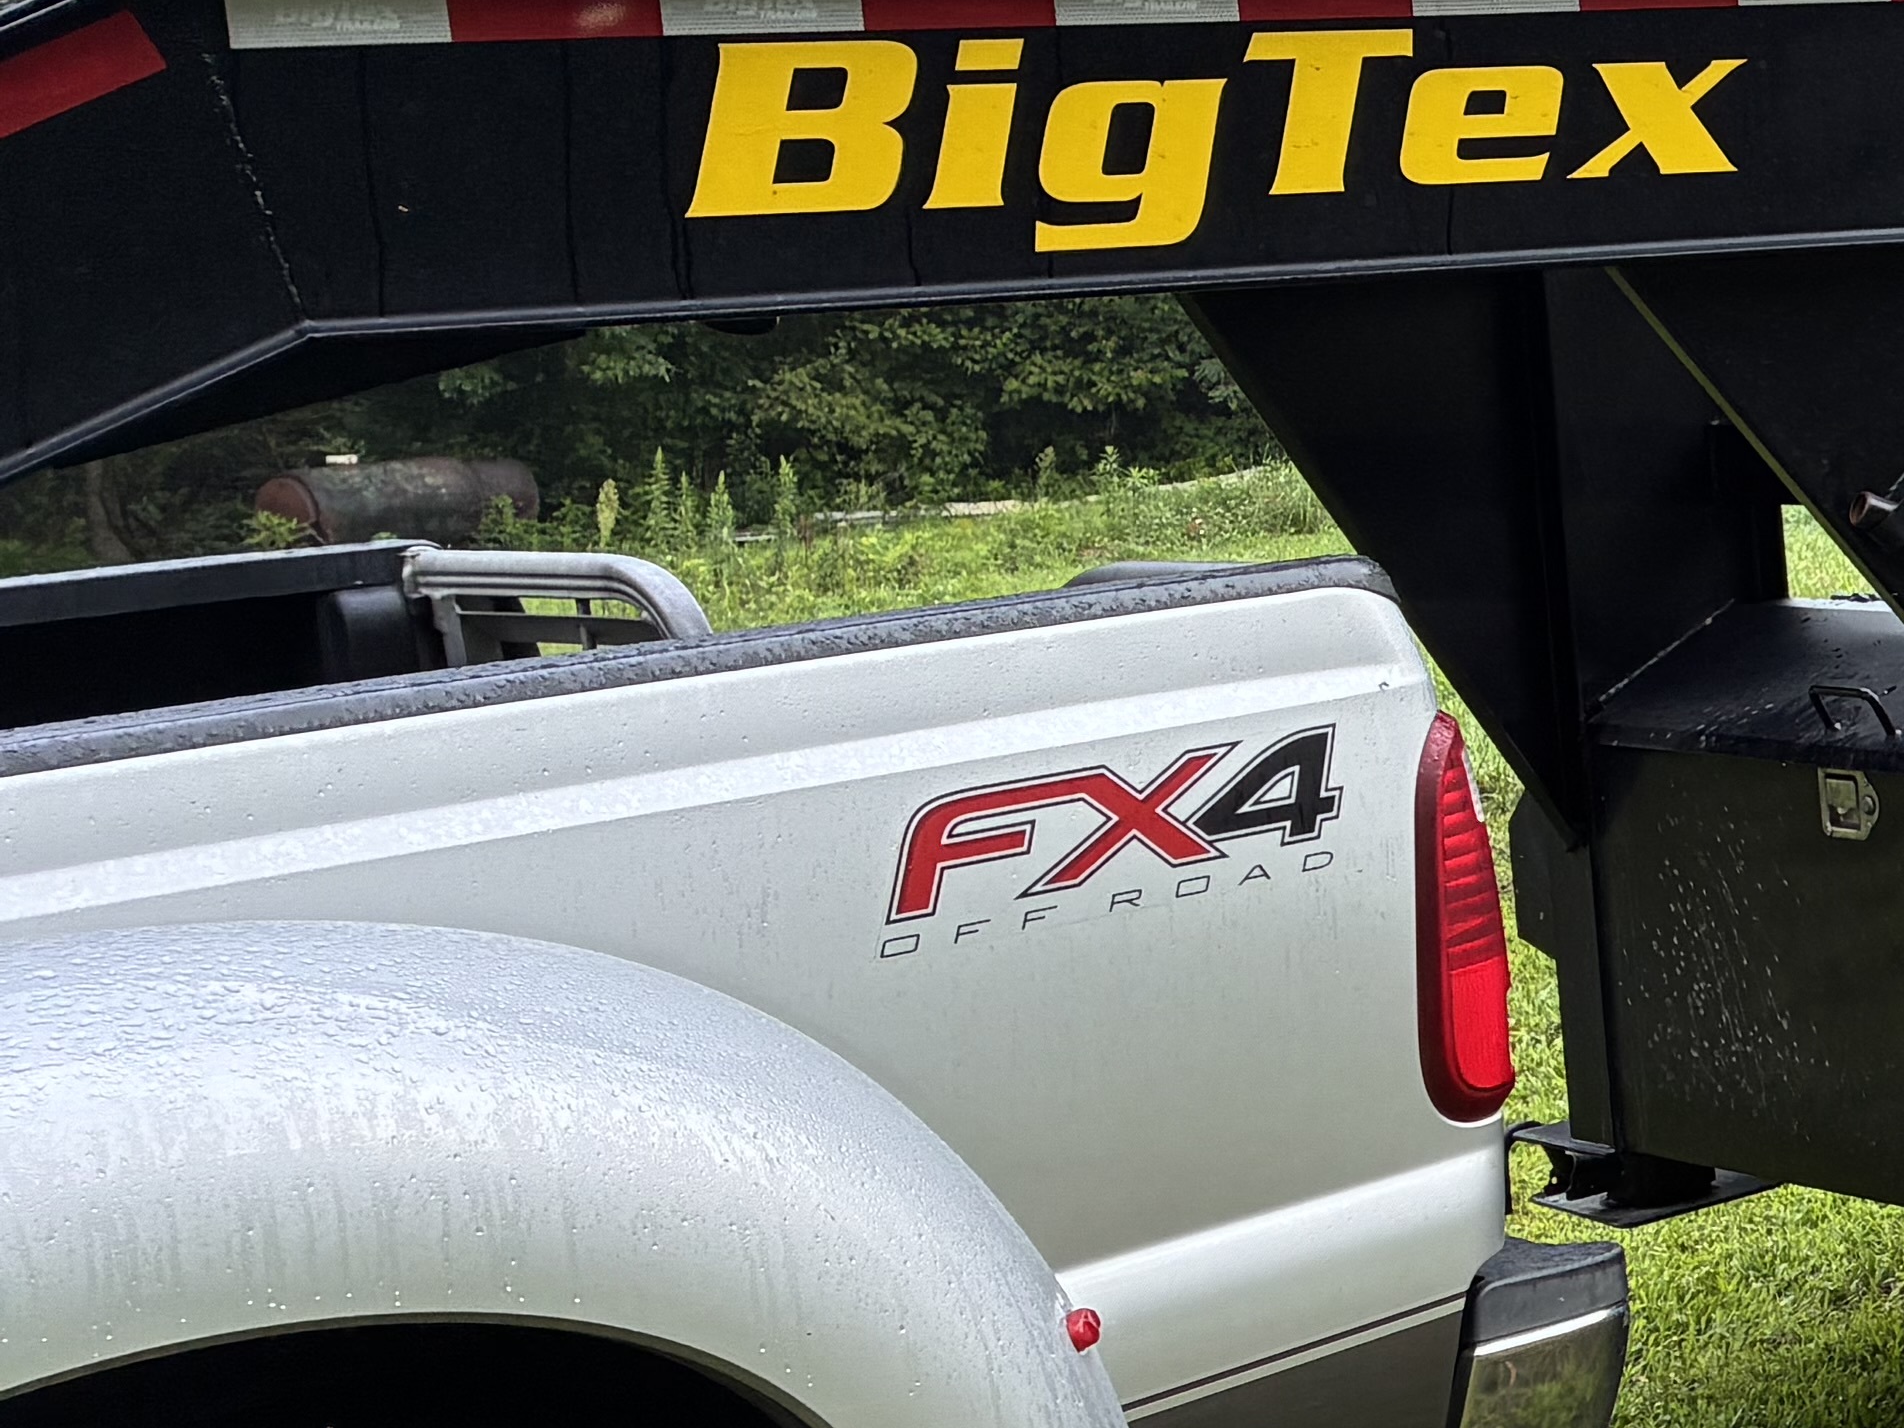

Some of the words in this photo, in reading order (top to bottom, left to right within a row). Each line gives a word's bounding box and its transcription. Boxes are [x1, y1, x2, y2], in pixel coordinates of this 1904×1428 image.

[684, 28, 1748, 252] BigTex
[880, 905, 1058, 959] OFF
[1109, 851, 1335, 912] ROAD
[885, 722, 1343, 925] FX4
